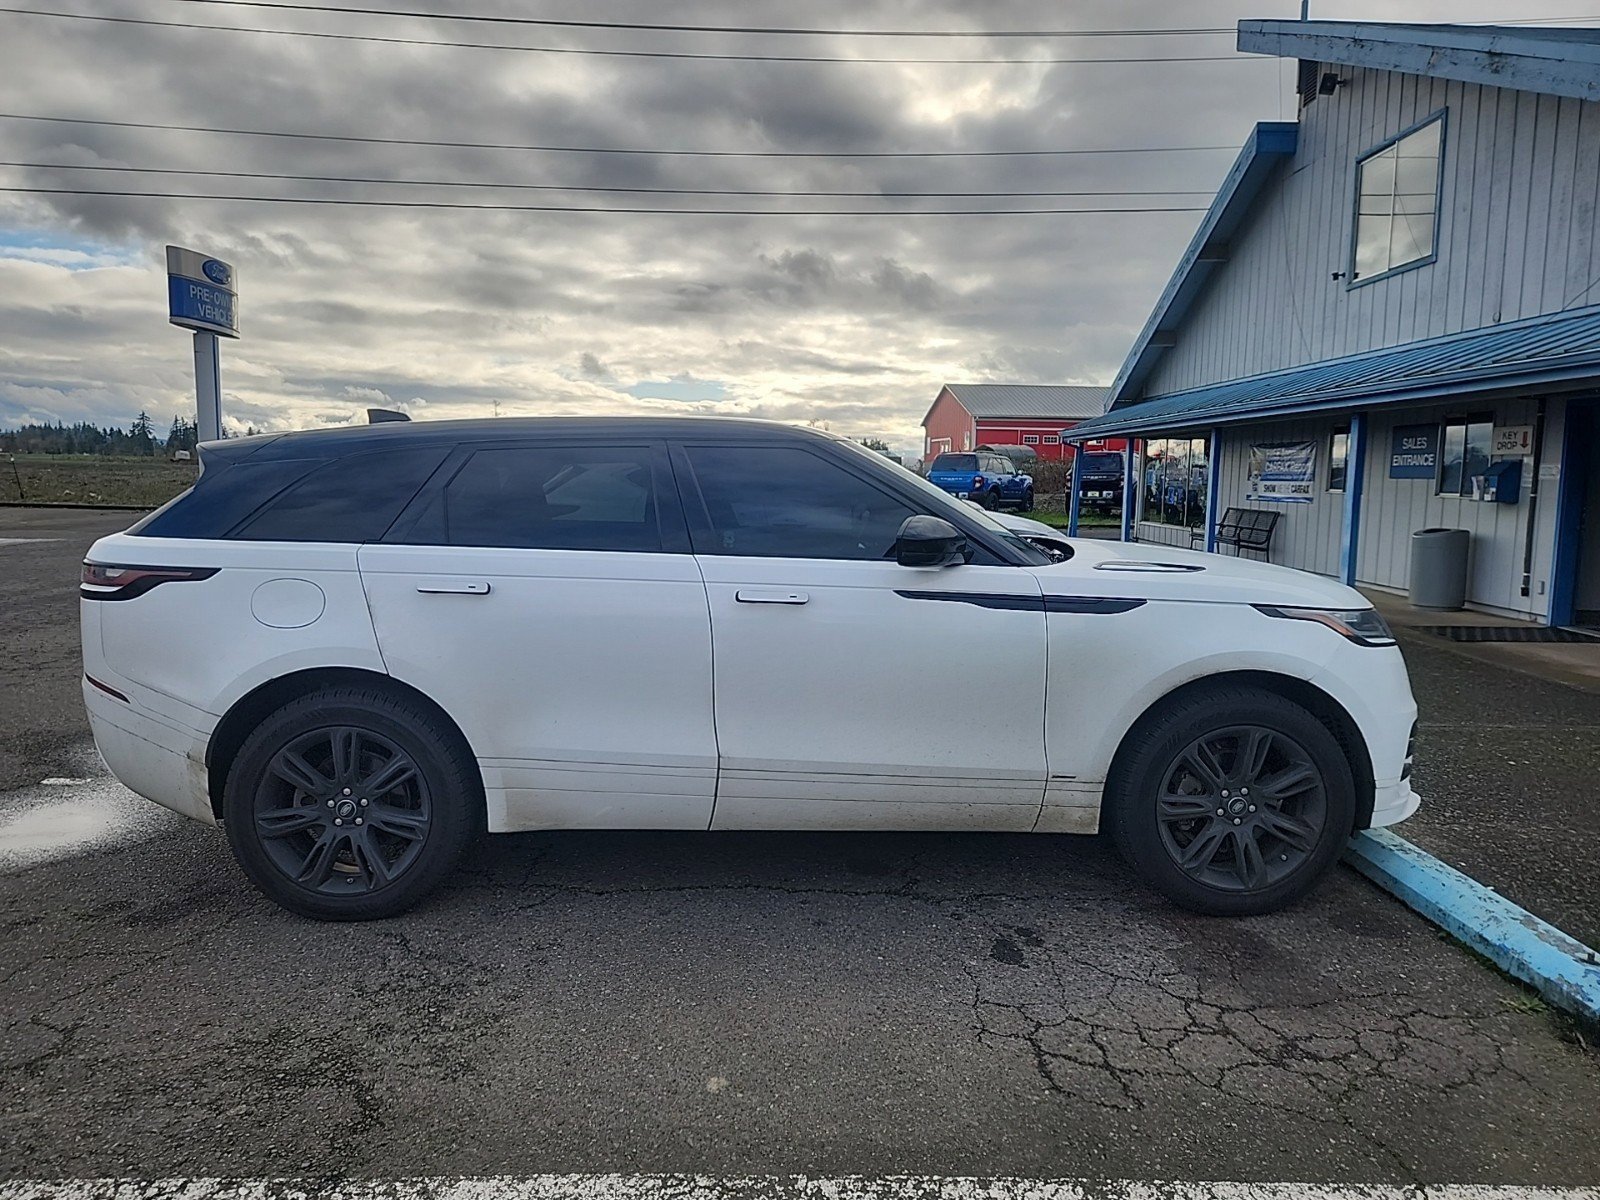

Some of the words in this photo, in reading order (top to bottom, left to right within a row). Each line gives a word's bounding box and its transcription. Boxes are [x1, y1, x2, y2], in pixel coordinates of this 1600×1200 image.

[198, 302, 232, 321] VEHICLE
[1502, 430, 1518, 440] KEY
[1402, 437, 1427, 449] SALES
[1497, 441, 1517, 450] DROP
[1392, 453, 1435, 467] ENTRANCE
